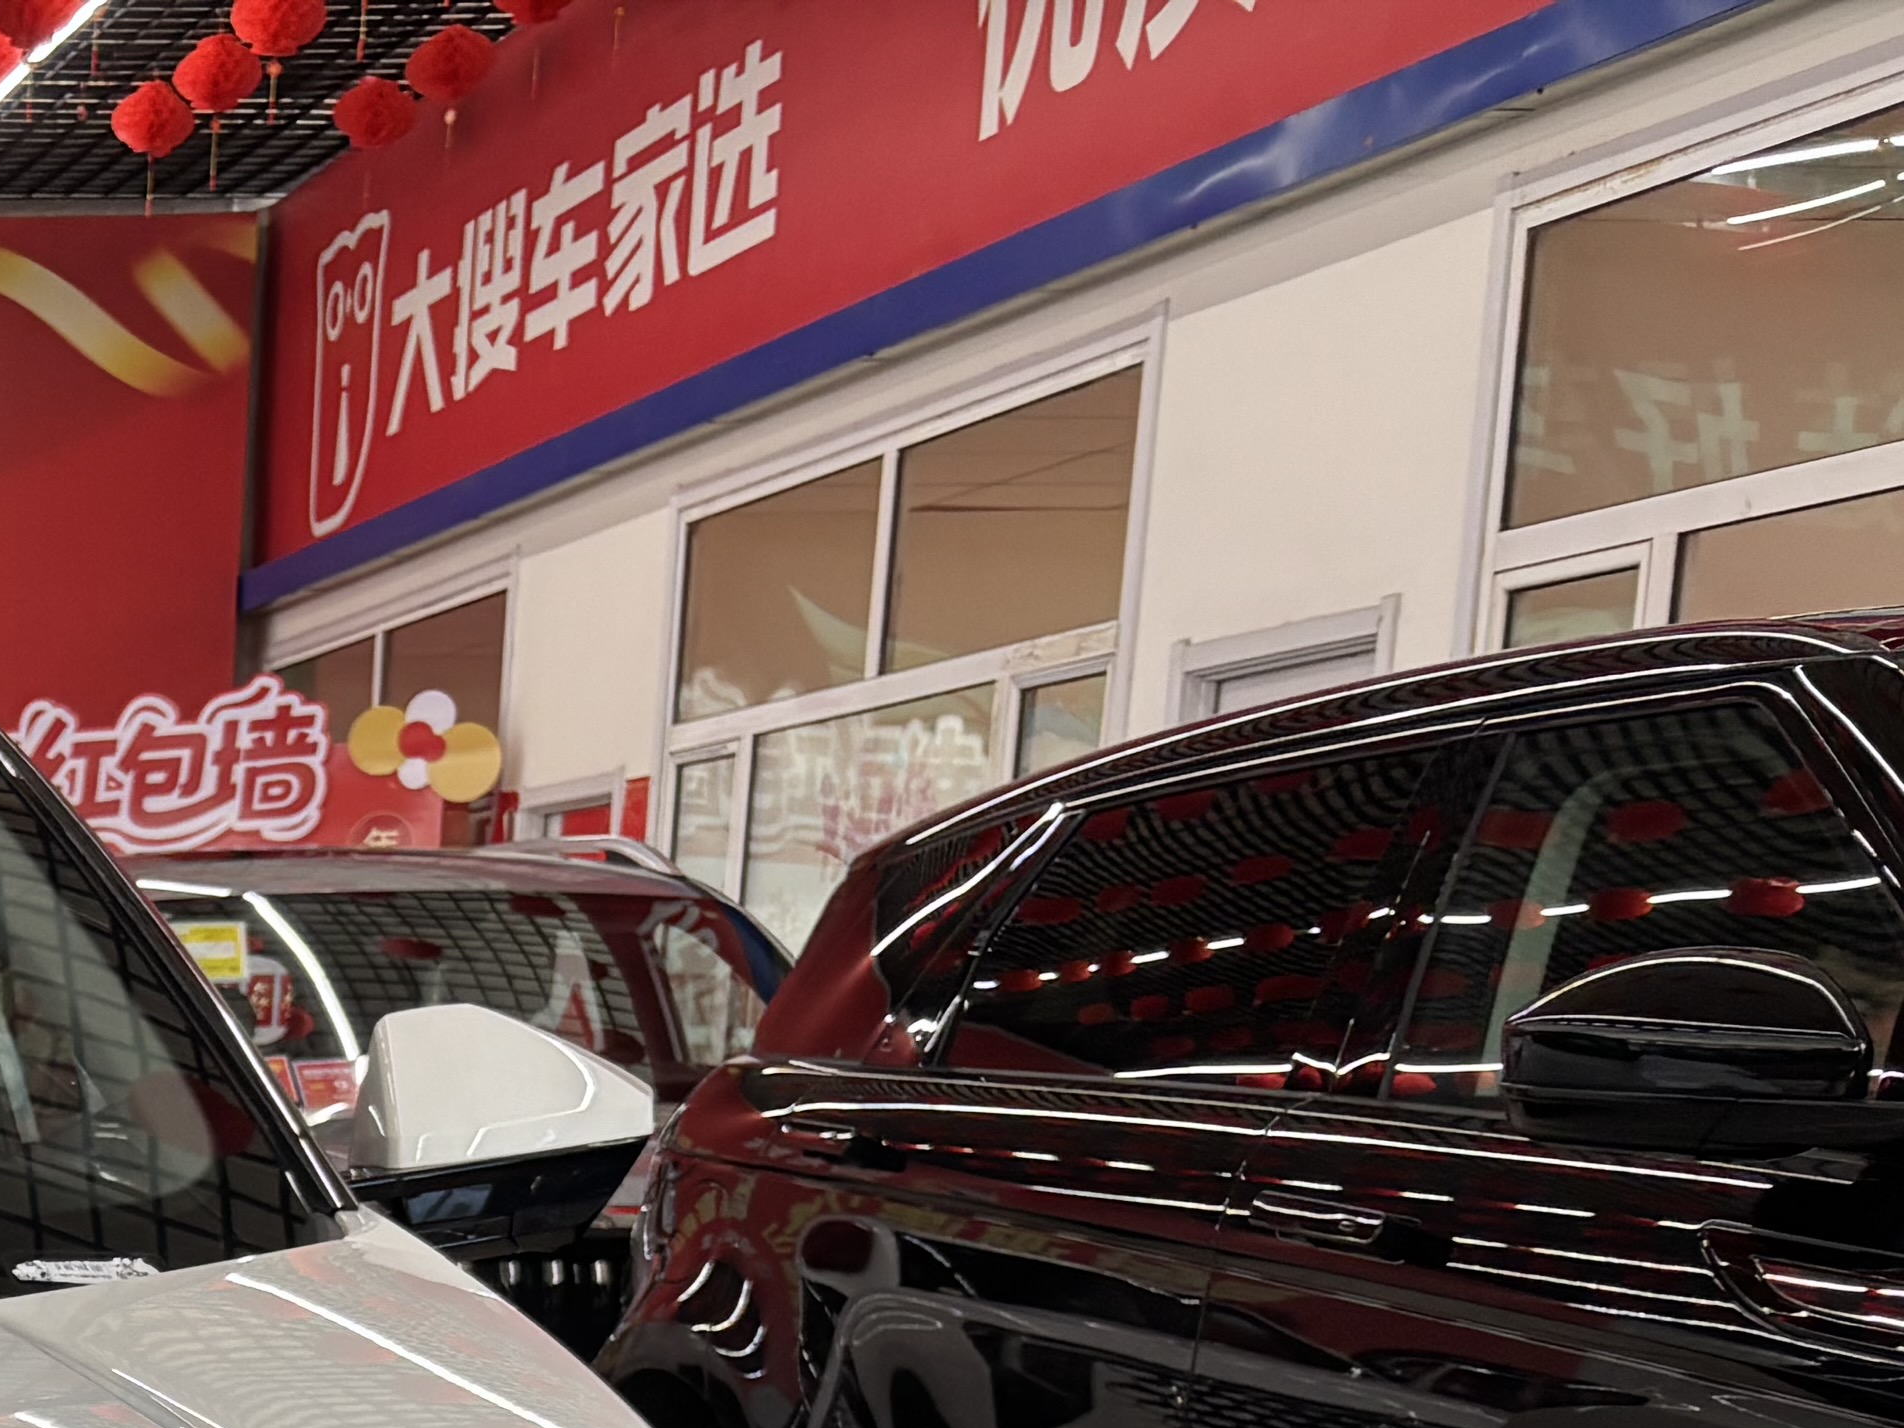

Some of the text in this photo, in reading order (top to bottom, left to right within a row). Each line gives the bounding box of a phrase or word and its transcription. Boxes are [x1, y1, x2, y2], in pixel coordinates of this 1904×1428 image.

[386, 39, 783, 436] 大搜车家选
[30, 685, 326, 830] 红包墙
